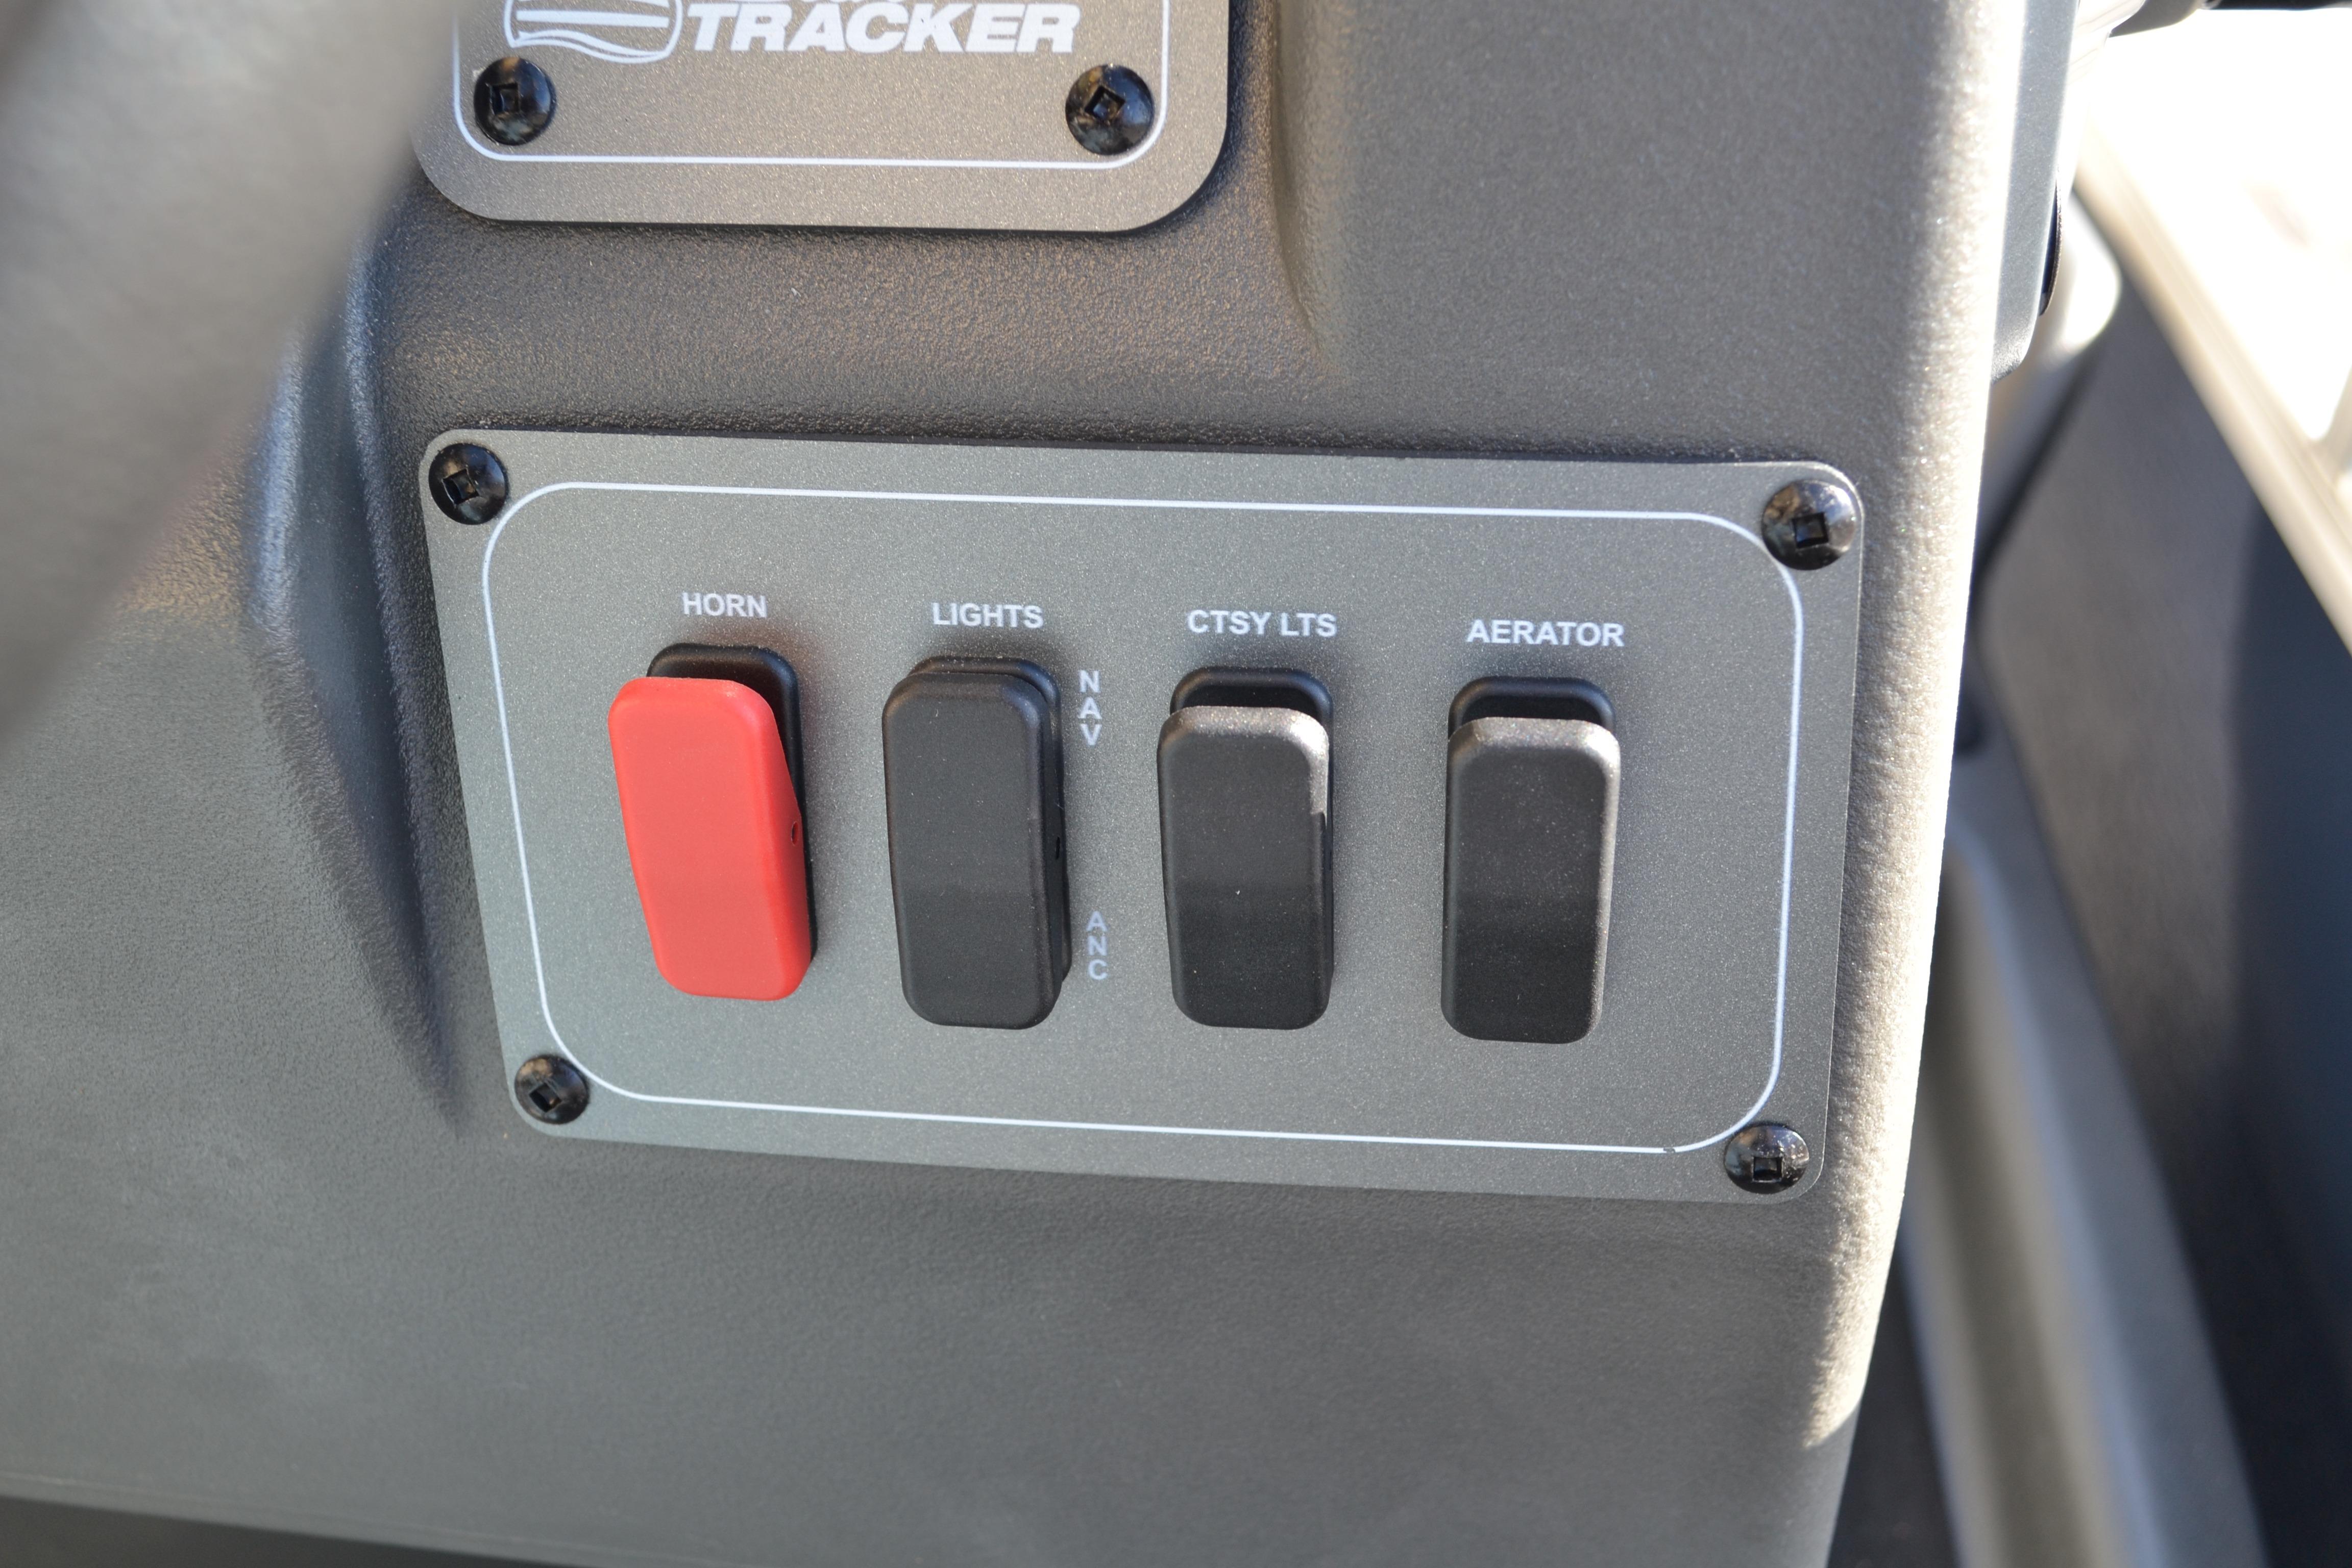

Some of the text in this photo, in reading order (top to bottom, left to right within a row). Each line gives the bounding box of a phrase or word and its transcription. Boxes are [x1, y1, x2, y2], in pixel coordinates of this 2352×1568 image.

[689, 3, 1081, 53] TRACKER
[681, 591, 767, 618] HORN
[932, 601, 1044, 629] LIGHTS
[1186, 608, 1337, 638] CTSY LTS
[1466, 618, 1625, 648] AERATOR
[1078, 669, 1103, 746] NAV
[1086, 910, 1108, 981] ANC
